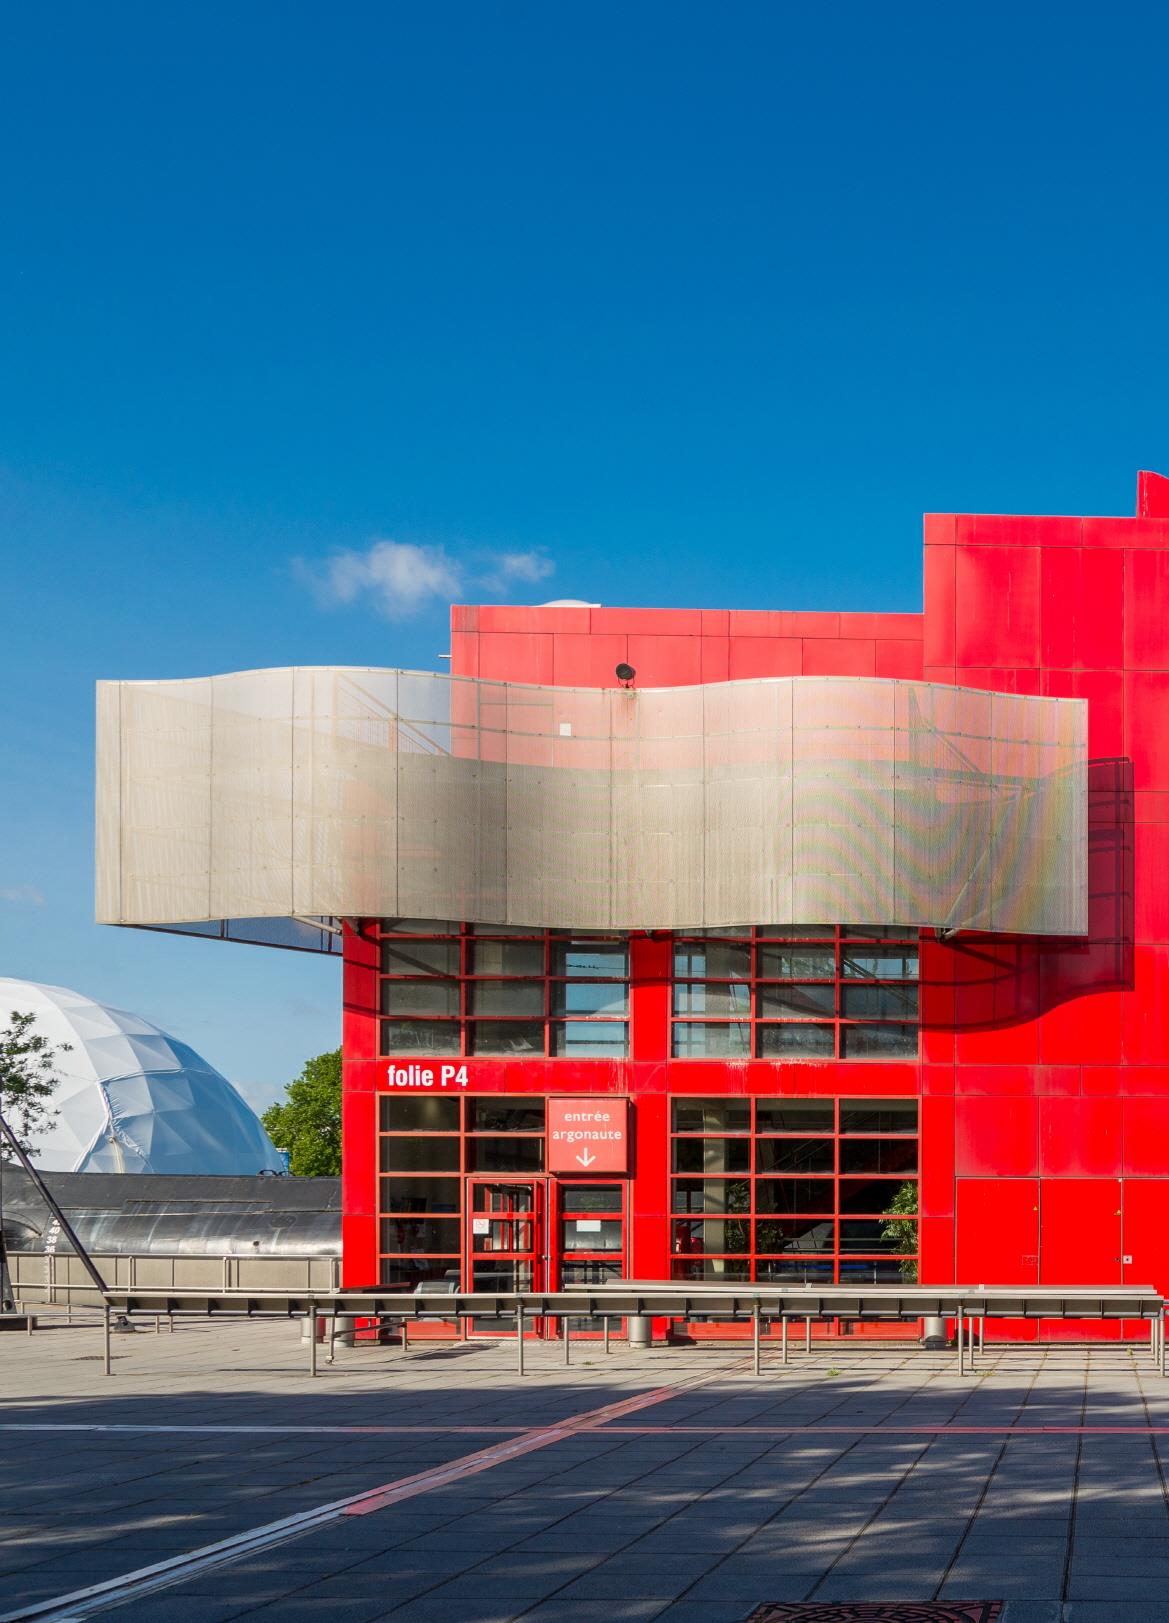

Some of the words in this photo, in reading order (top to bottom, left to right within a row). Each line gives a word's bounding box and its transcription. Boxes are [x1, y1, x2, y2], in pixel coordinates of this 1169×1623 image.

[387, 1065, 434, 1087] folie
[441, 1065, 469, 1087] P4
[564, 1110, 610, 1122] entrée
[552, 1130, 622, 1143] argonaute
[49, 1226, 61, 1234] 40
[46, 1236, 57, 1244] 38
